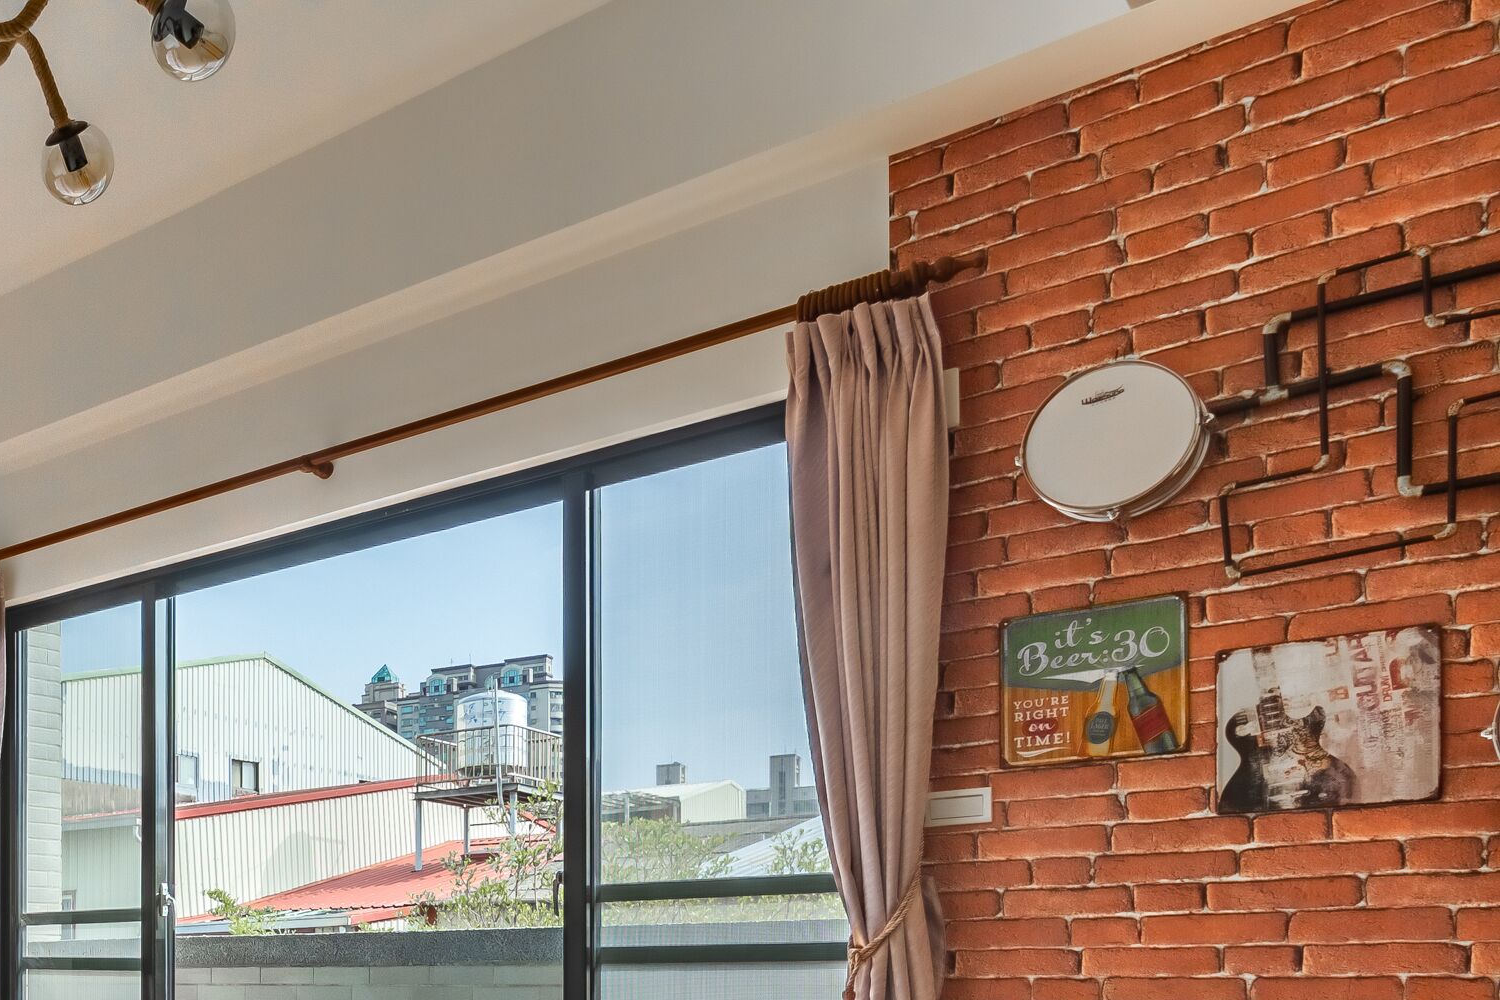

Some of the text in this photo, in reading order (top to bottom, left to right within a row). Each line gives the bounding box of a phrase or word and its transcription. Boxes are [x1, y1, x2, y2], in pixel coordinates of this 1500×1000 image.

[1054, 617, 1110, 649] it's
[1017, 626, 1170, 677] Beer:30
[1014, 695, 1069, 710] YOU'RE
[1014, 706, 1069, 722] RIGHT
[1028, 722, 1056, 733] on
[1014, 731, 1071, 748] TIME!
